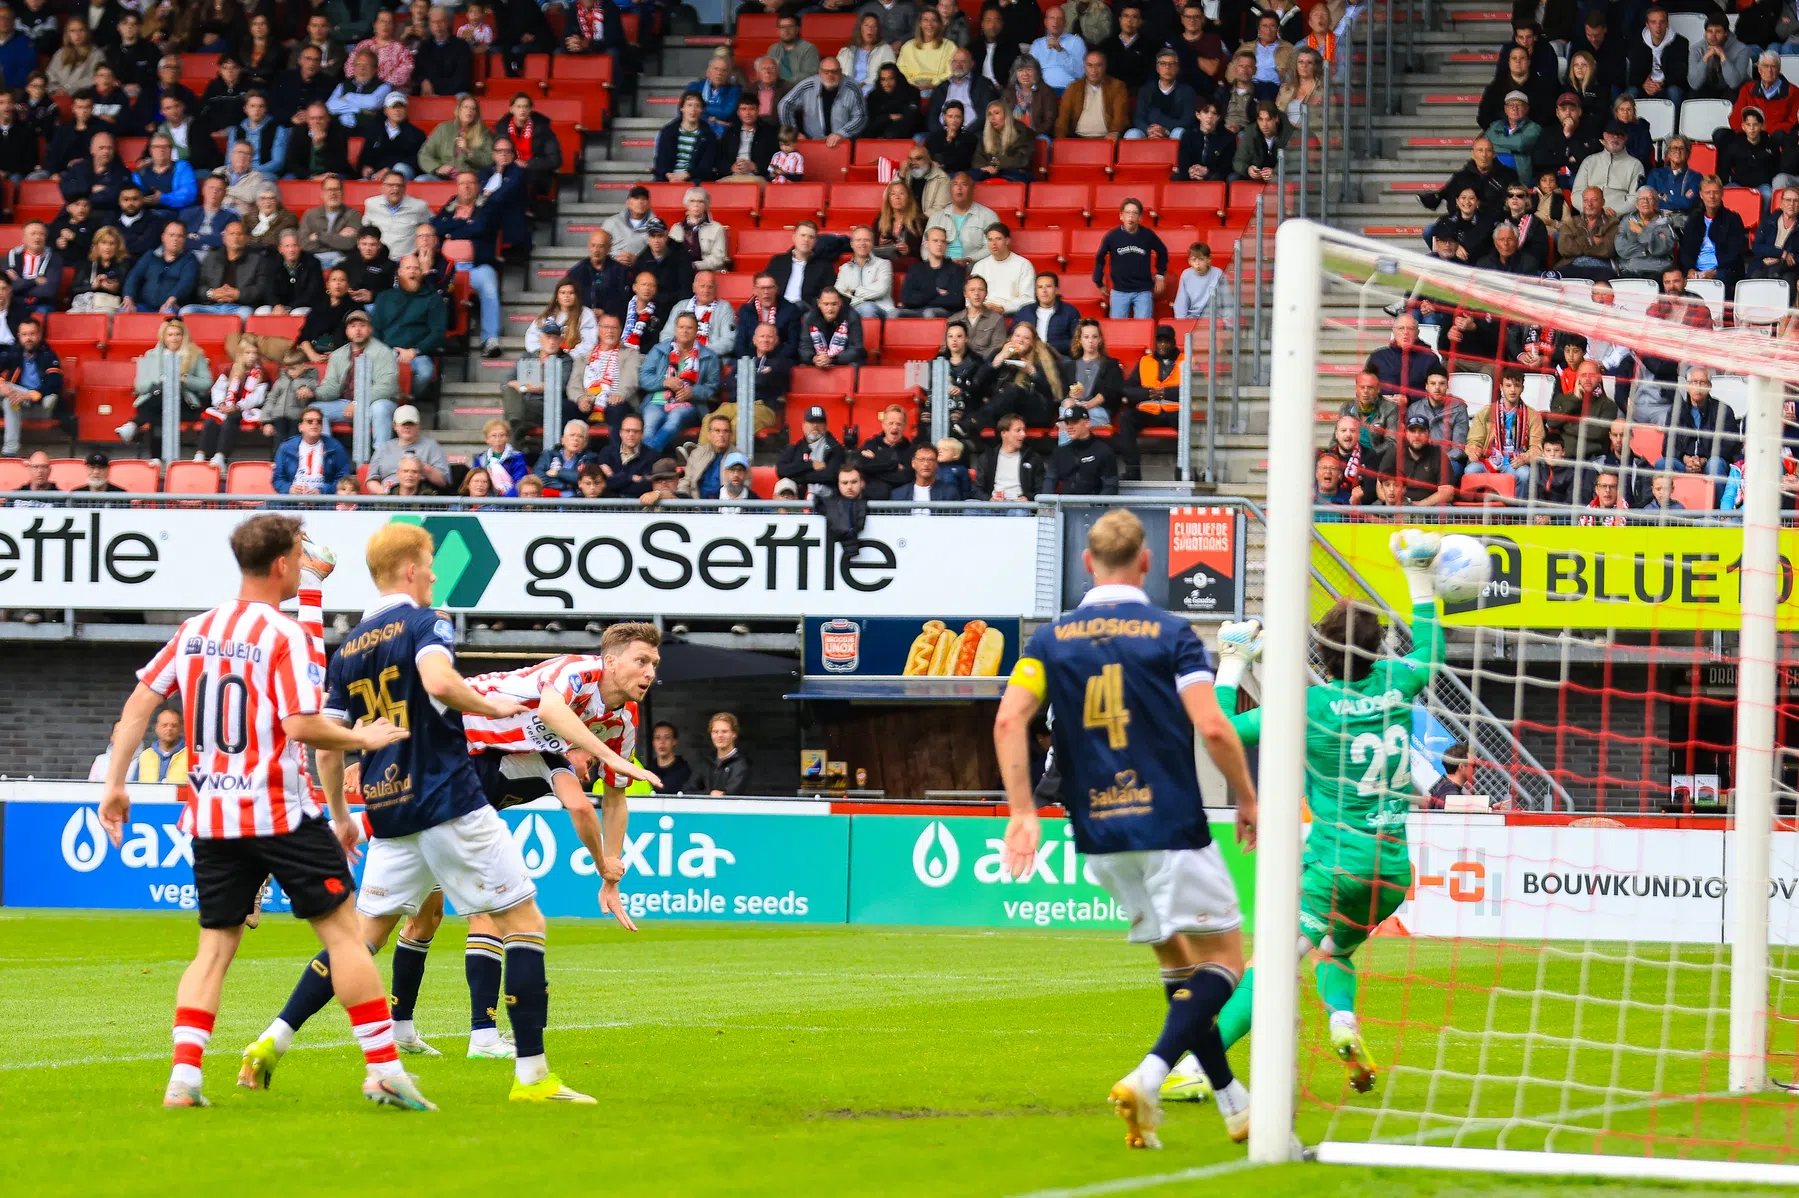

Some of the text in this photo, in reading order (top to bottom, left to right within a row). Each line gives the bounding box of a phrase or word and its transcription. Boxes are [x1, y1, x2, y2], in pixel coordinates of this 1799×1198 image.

[524, 519, 897, 609] goSettle
[206, 640, 262, 664] BLUE10
[193, 671, 249, 755] 10
[1082, 663, 1131, 750] 4
[363, 773, 412, 800] Salland
[1089, 785, 1153, 807] Salland
[1523, 872, 1728, 900] BOUWKUNDIG
[620, 888, 809, 918] egetable seeds
